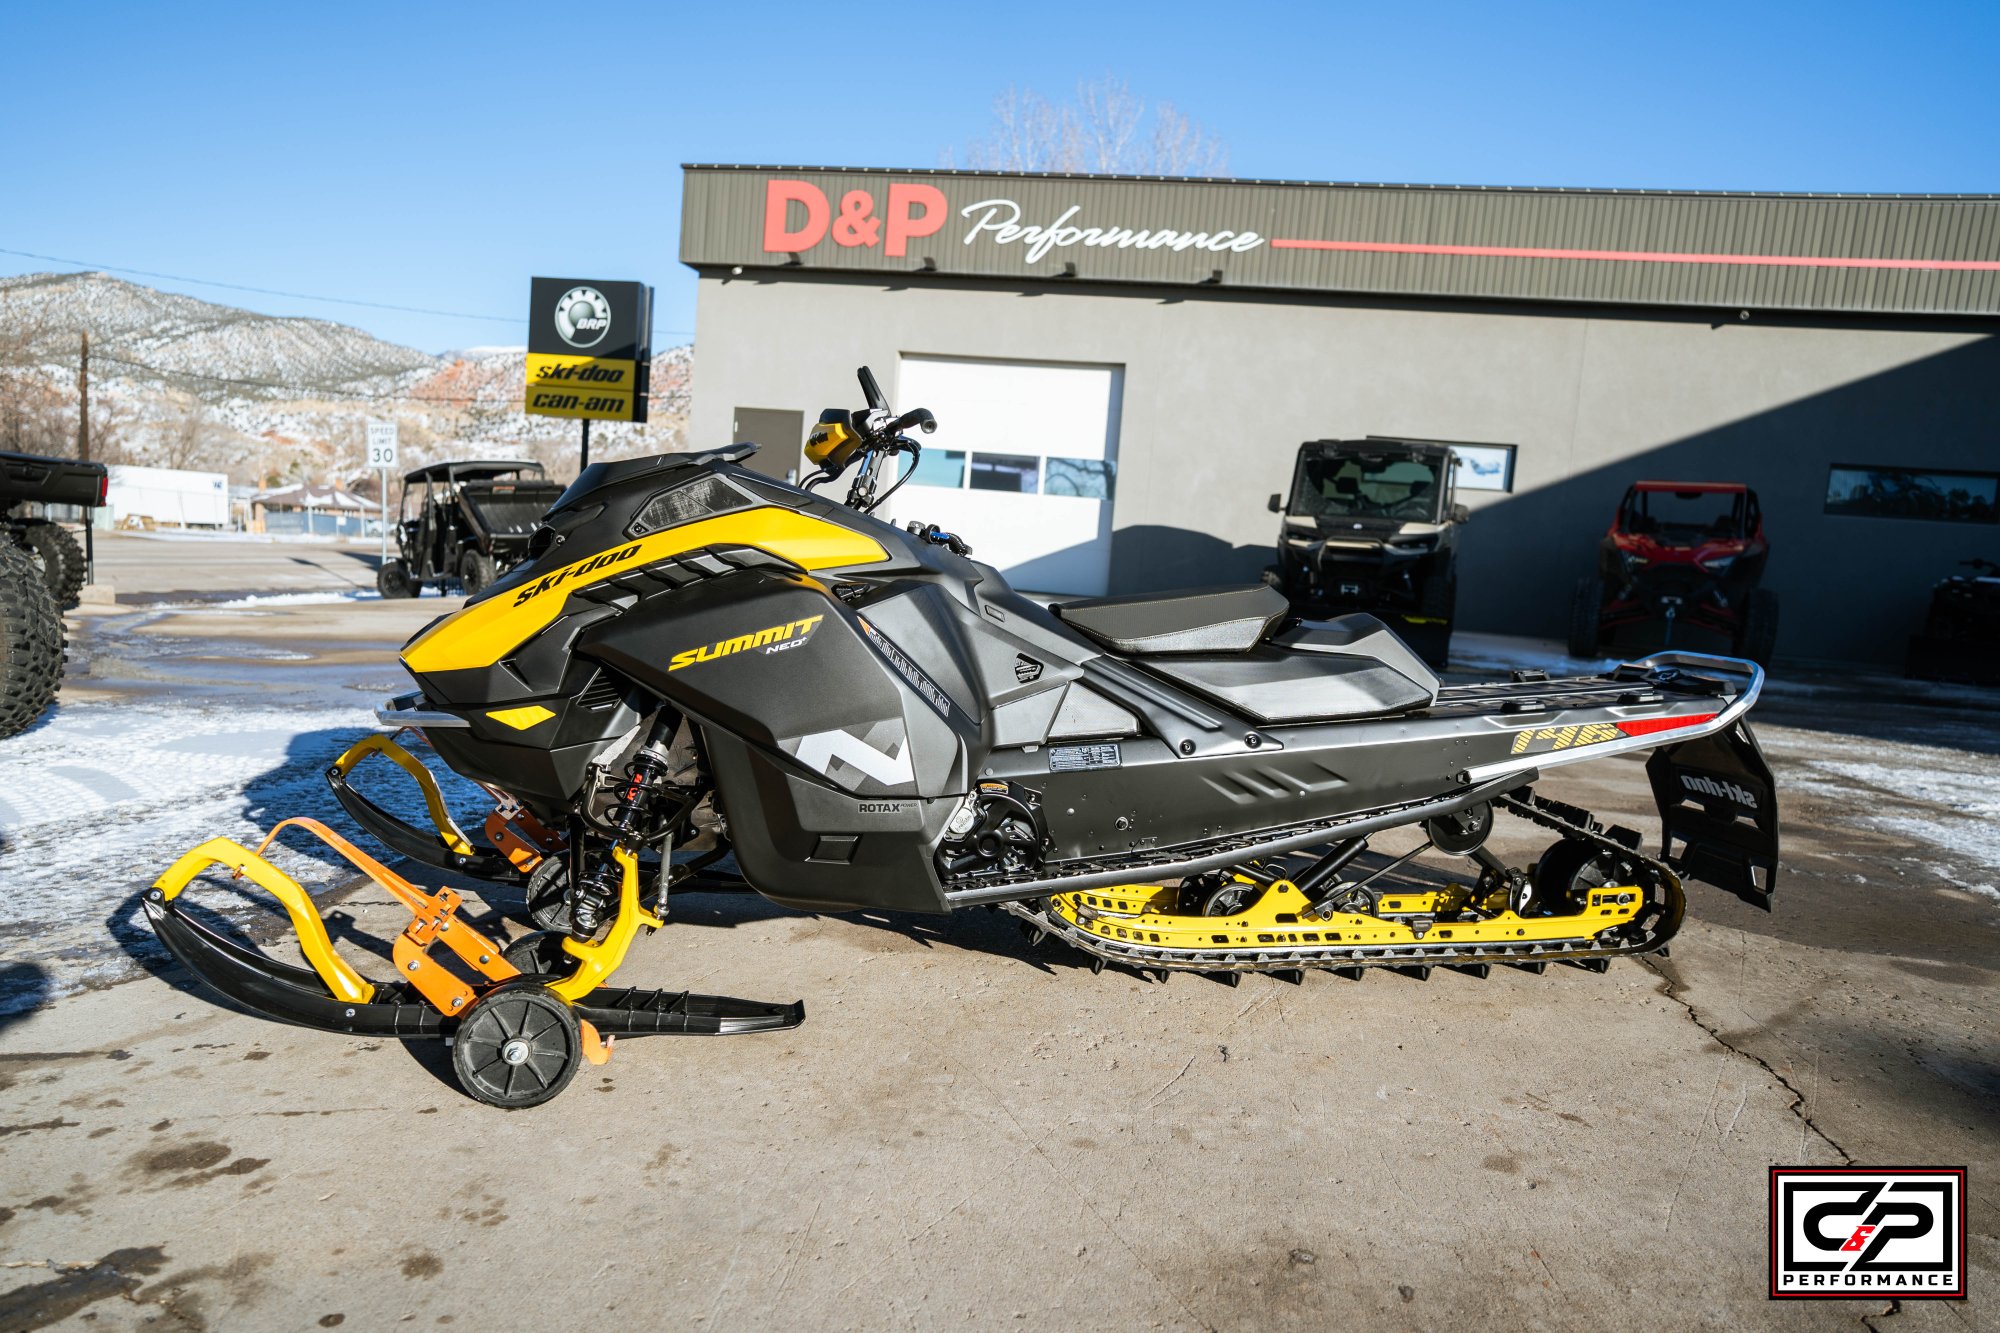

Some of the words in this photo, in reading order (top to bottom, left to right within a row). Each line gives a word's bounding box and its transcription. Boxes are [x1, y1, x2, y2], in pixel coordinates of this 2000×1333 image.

[763, 179, 948, 257] D&P
[961, 199, 1265, 264] Performance
[536, 363, 625, 383] ski-doo
[532, 393, 625, 413] can-am
[372, 448, 393, 463] 30
[668, 614, 824, 671] SUMMIT
[859, 803, 900, 813] ROTAX
